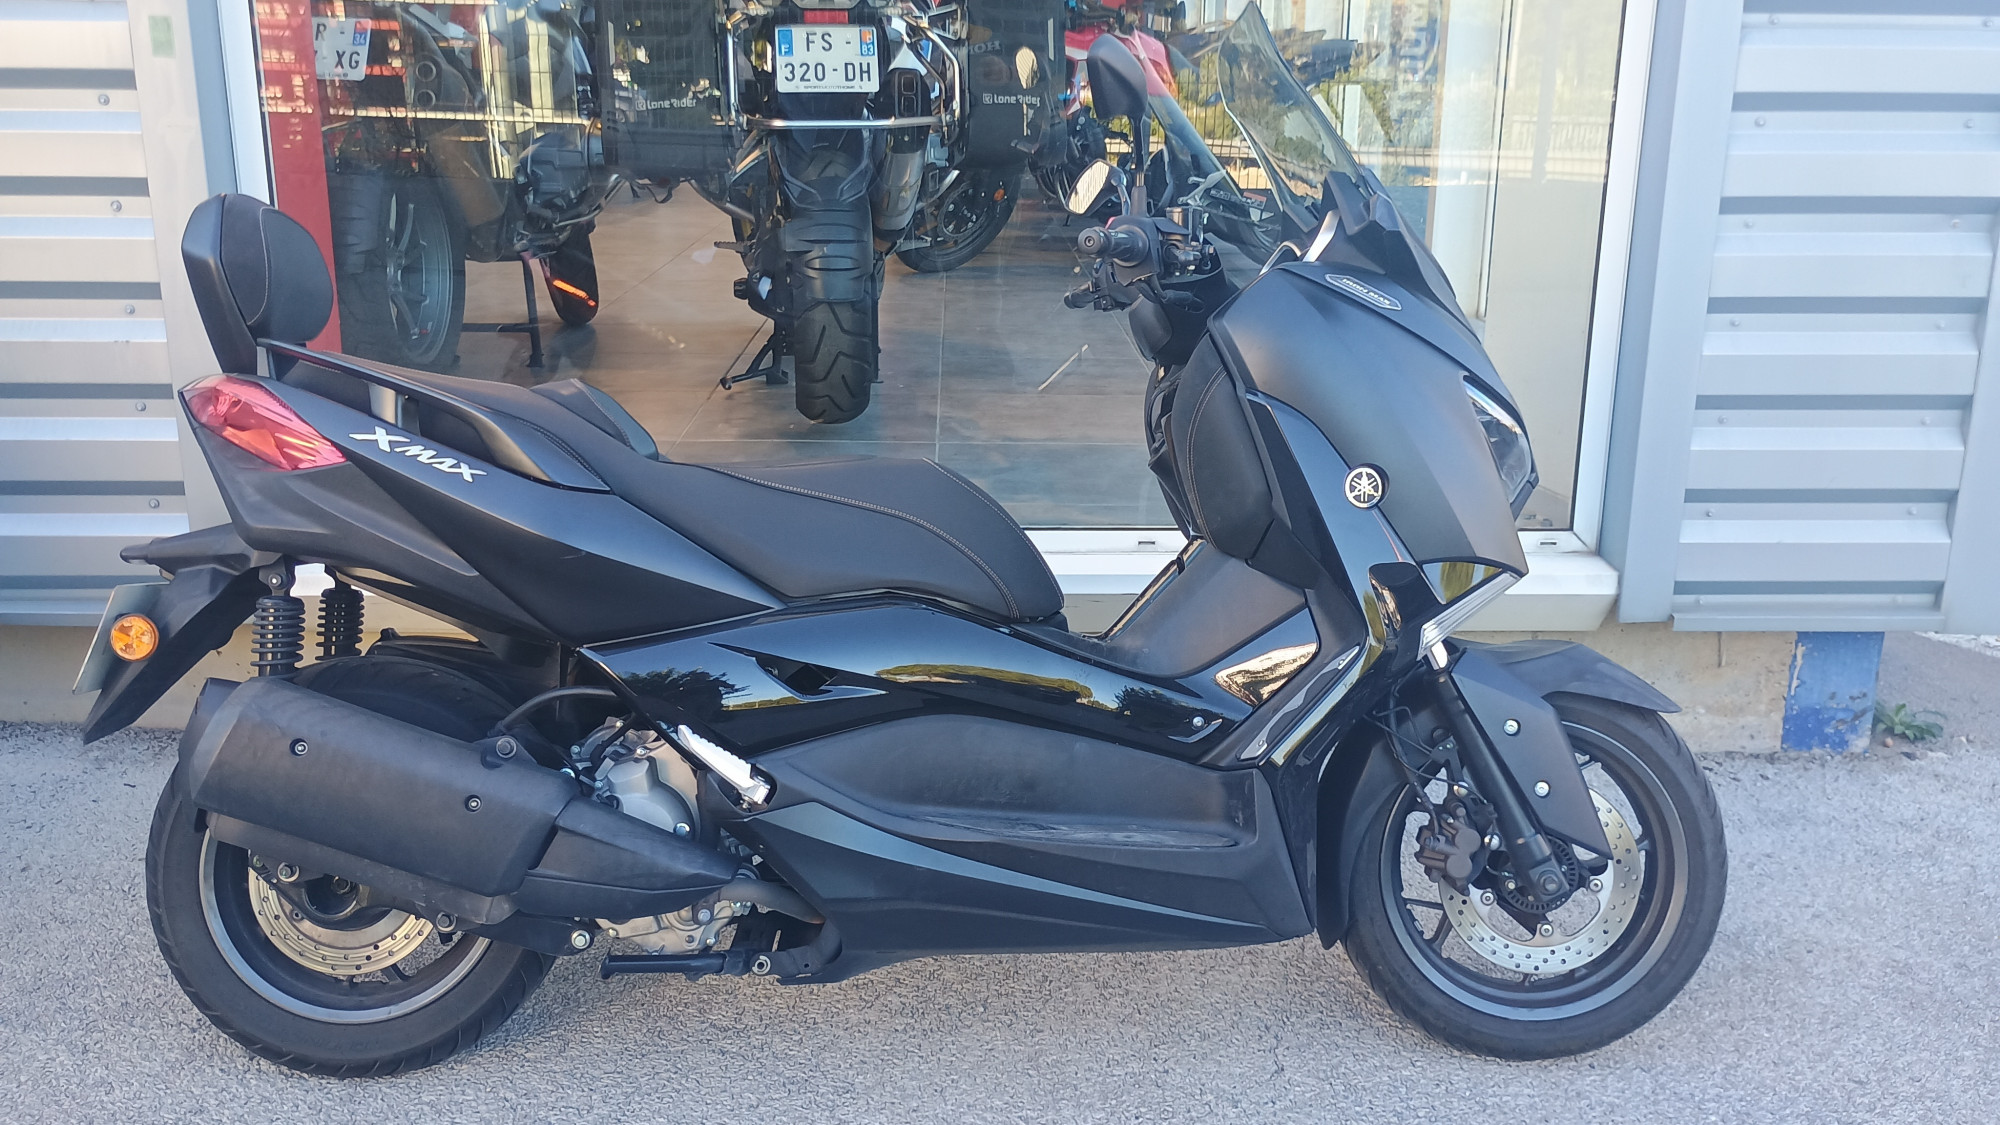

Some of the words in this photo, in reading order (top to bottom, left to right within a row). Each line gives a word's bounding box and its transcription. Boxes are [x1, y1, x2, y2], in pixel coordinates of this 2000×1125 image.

[781, 44, 790, 56] F
[861, 45, 875, 56] 83
[647, 99, 671, 110] Lone
[671, 97, 697, 108] Rider
[994, 93, 1017, 104] Lone
